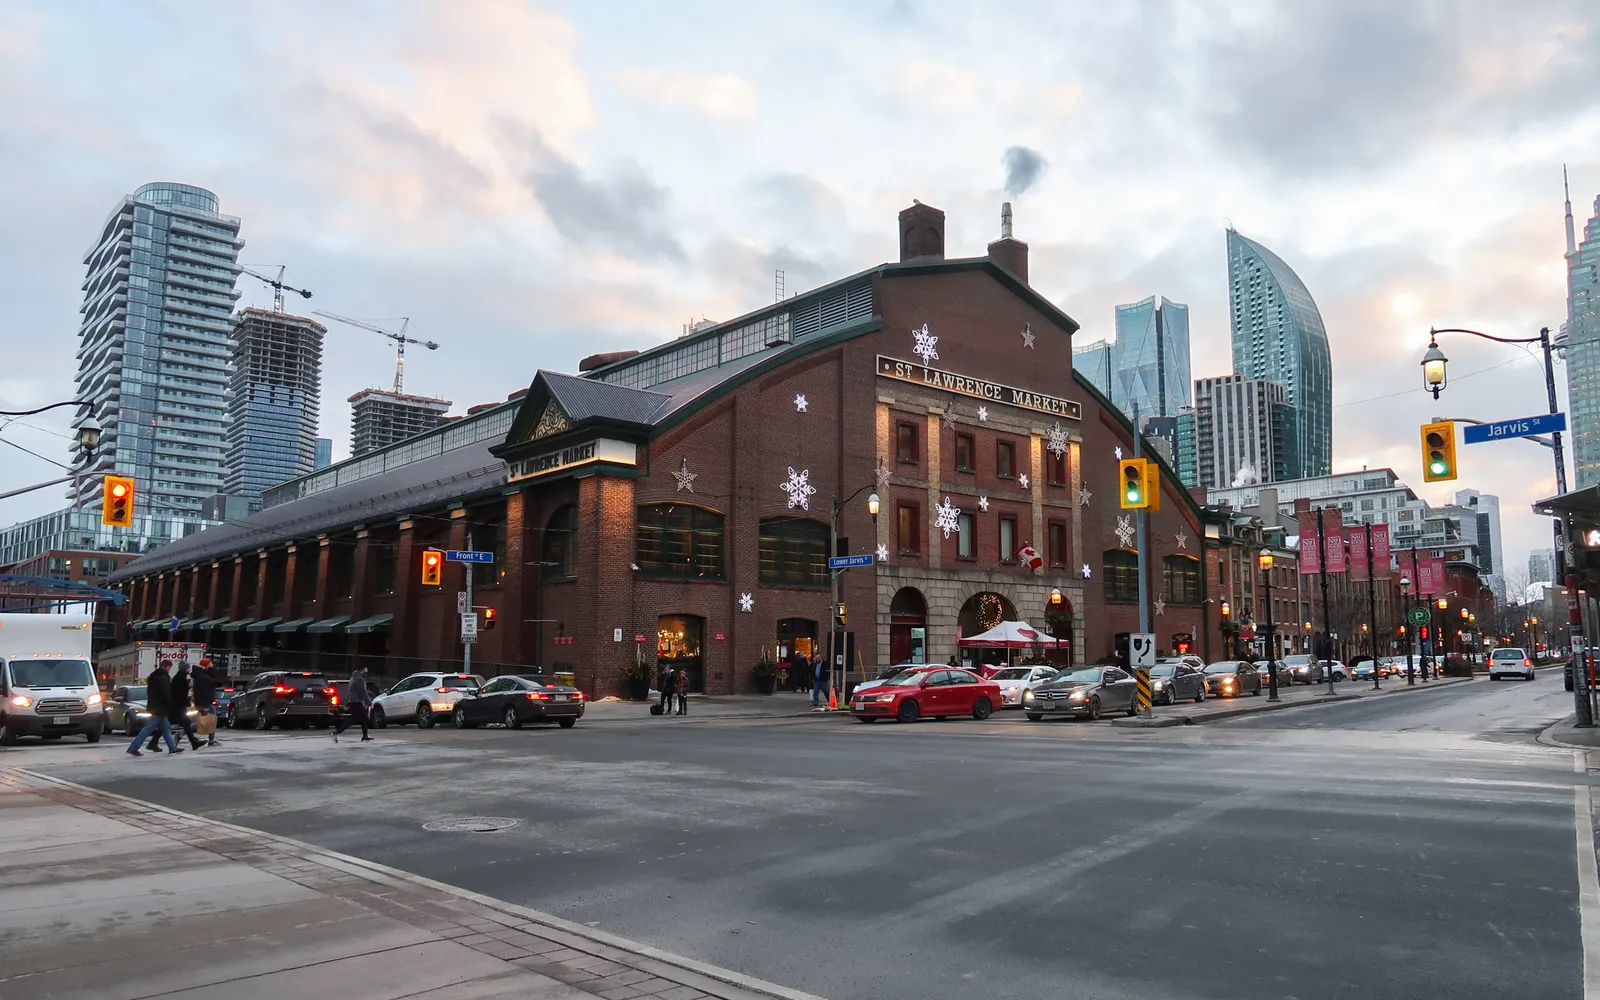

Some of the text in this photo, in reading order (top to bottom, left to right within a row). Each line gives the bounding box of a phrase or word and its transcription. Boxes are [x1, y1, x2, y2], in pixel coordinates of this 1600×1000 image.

[923, 368, 1002, 400] LAWRENCE
[1012, 389, 1068, 414] MARKET
[1487, 418, 1541, 437] Jarvis St
[520, 451, 560, 476] LAWRENCE
[562, 440, 597, 466] MARKET
[456, 551, 474, 560] Front
[833, 558, 849, 566] Lower
[849, 557, 864, 565] Jarvis
[1415, 611, 1424, 620] P
